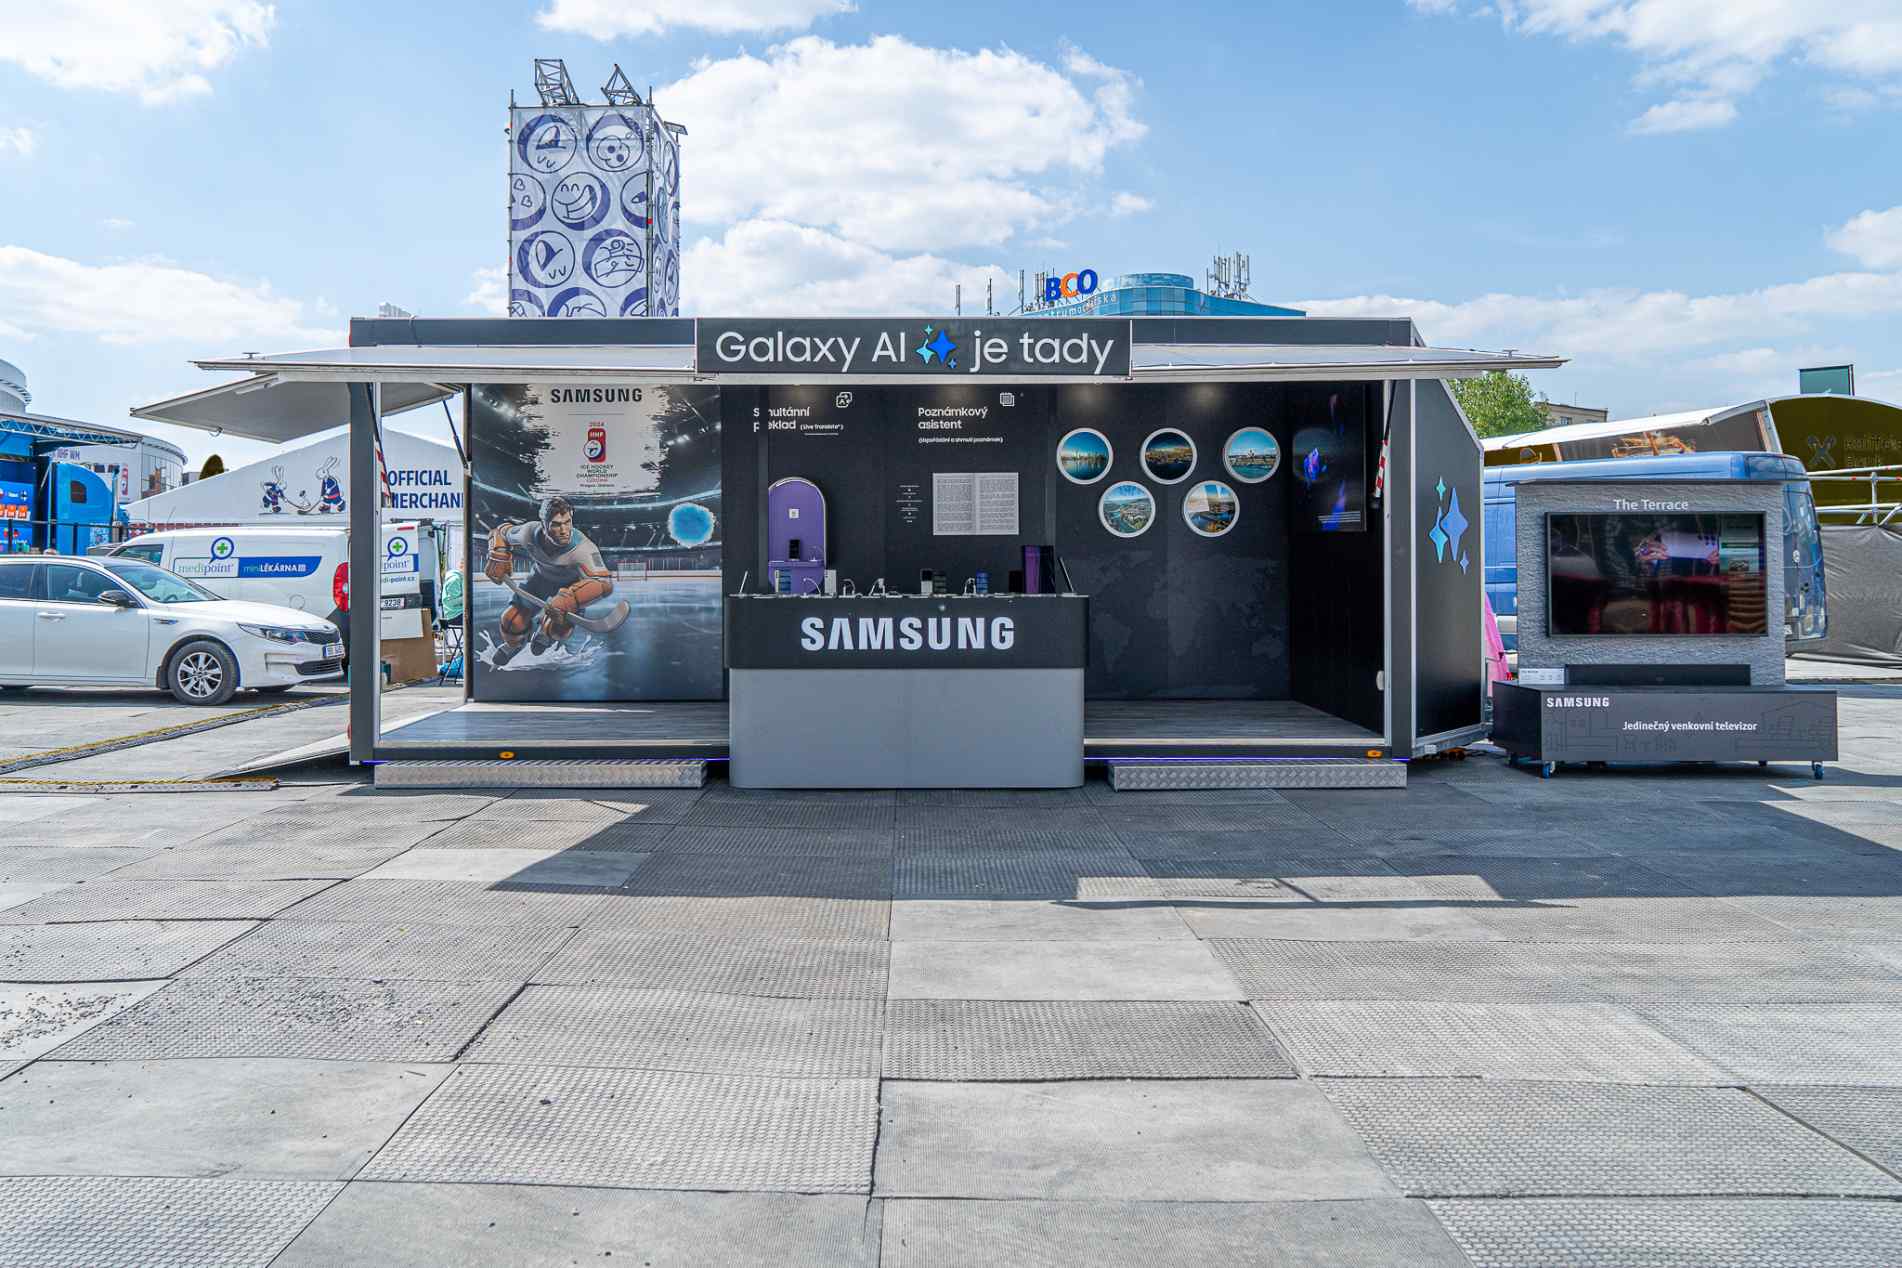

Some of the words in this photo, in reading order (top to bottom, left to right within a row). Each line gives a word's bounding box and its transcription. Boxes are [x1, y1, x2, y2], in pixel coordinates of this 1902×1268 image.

[1046, 269, 1098, 302] BCO
[715, 331, 860, 372] Galaxy
[872, 332, 905, 362] AI
[969, 330, 1008, 373] je
[1019, 331, 1114, 374] tady
[551, 388, 642, 403] SAMSUNG
[918, 407, 988, 419] Poznámkový
[918, 420, 962, 429] asistent
[388, 470, 452, 486] OFFICIAL
[1613, 499, 1638, 510] The
[1641, 499, 1689, 510] Terrace
[800, 616, 1015, 650] SAMSUNG
[1546, 697, 1610, 707] SAMSUNG
[1622, 720, 1670, 732] Jedinečný
[1671, 720, 1714, 731] venkovní
[1715, 721, 1758, 731] televizor
